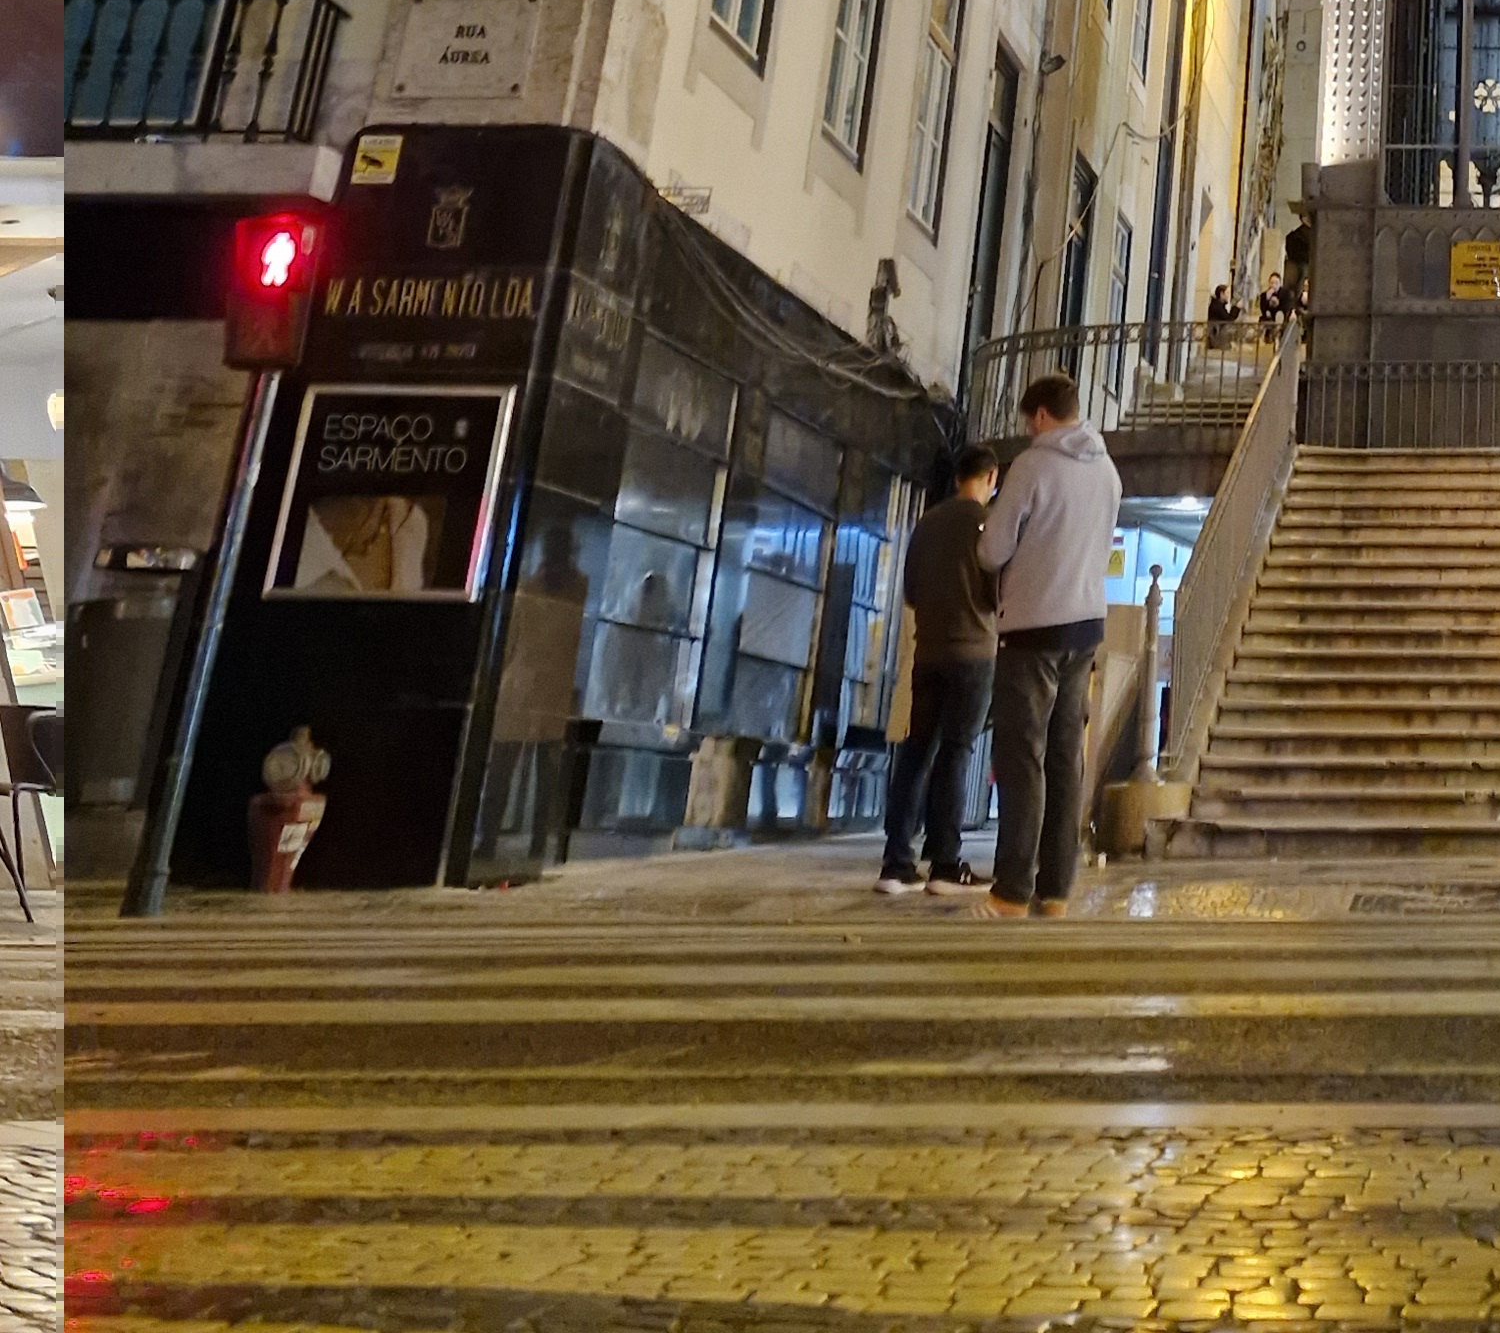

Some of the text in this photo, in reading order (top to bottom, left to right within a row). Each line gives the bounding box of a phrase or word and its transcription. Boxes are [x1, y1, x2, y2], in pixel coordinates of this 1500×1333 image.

[454, 24, 487, 39] RUA
[438, 45, 491, 65] ÁUREA
[323, 415, 433, 446] ESPAÇO
[317, 446, 467, 473] SARMENTO
